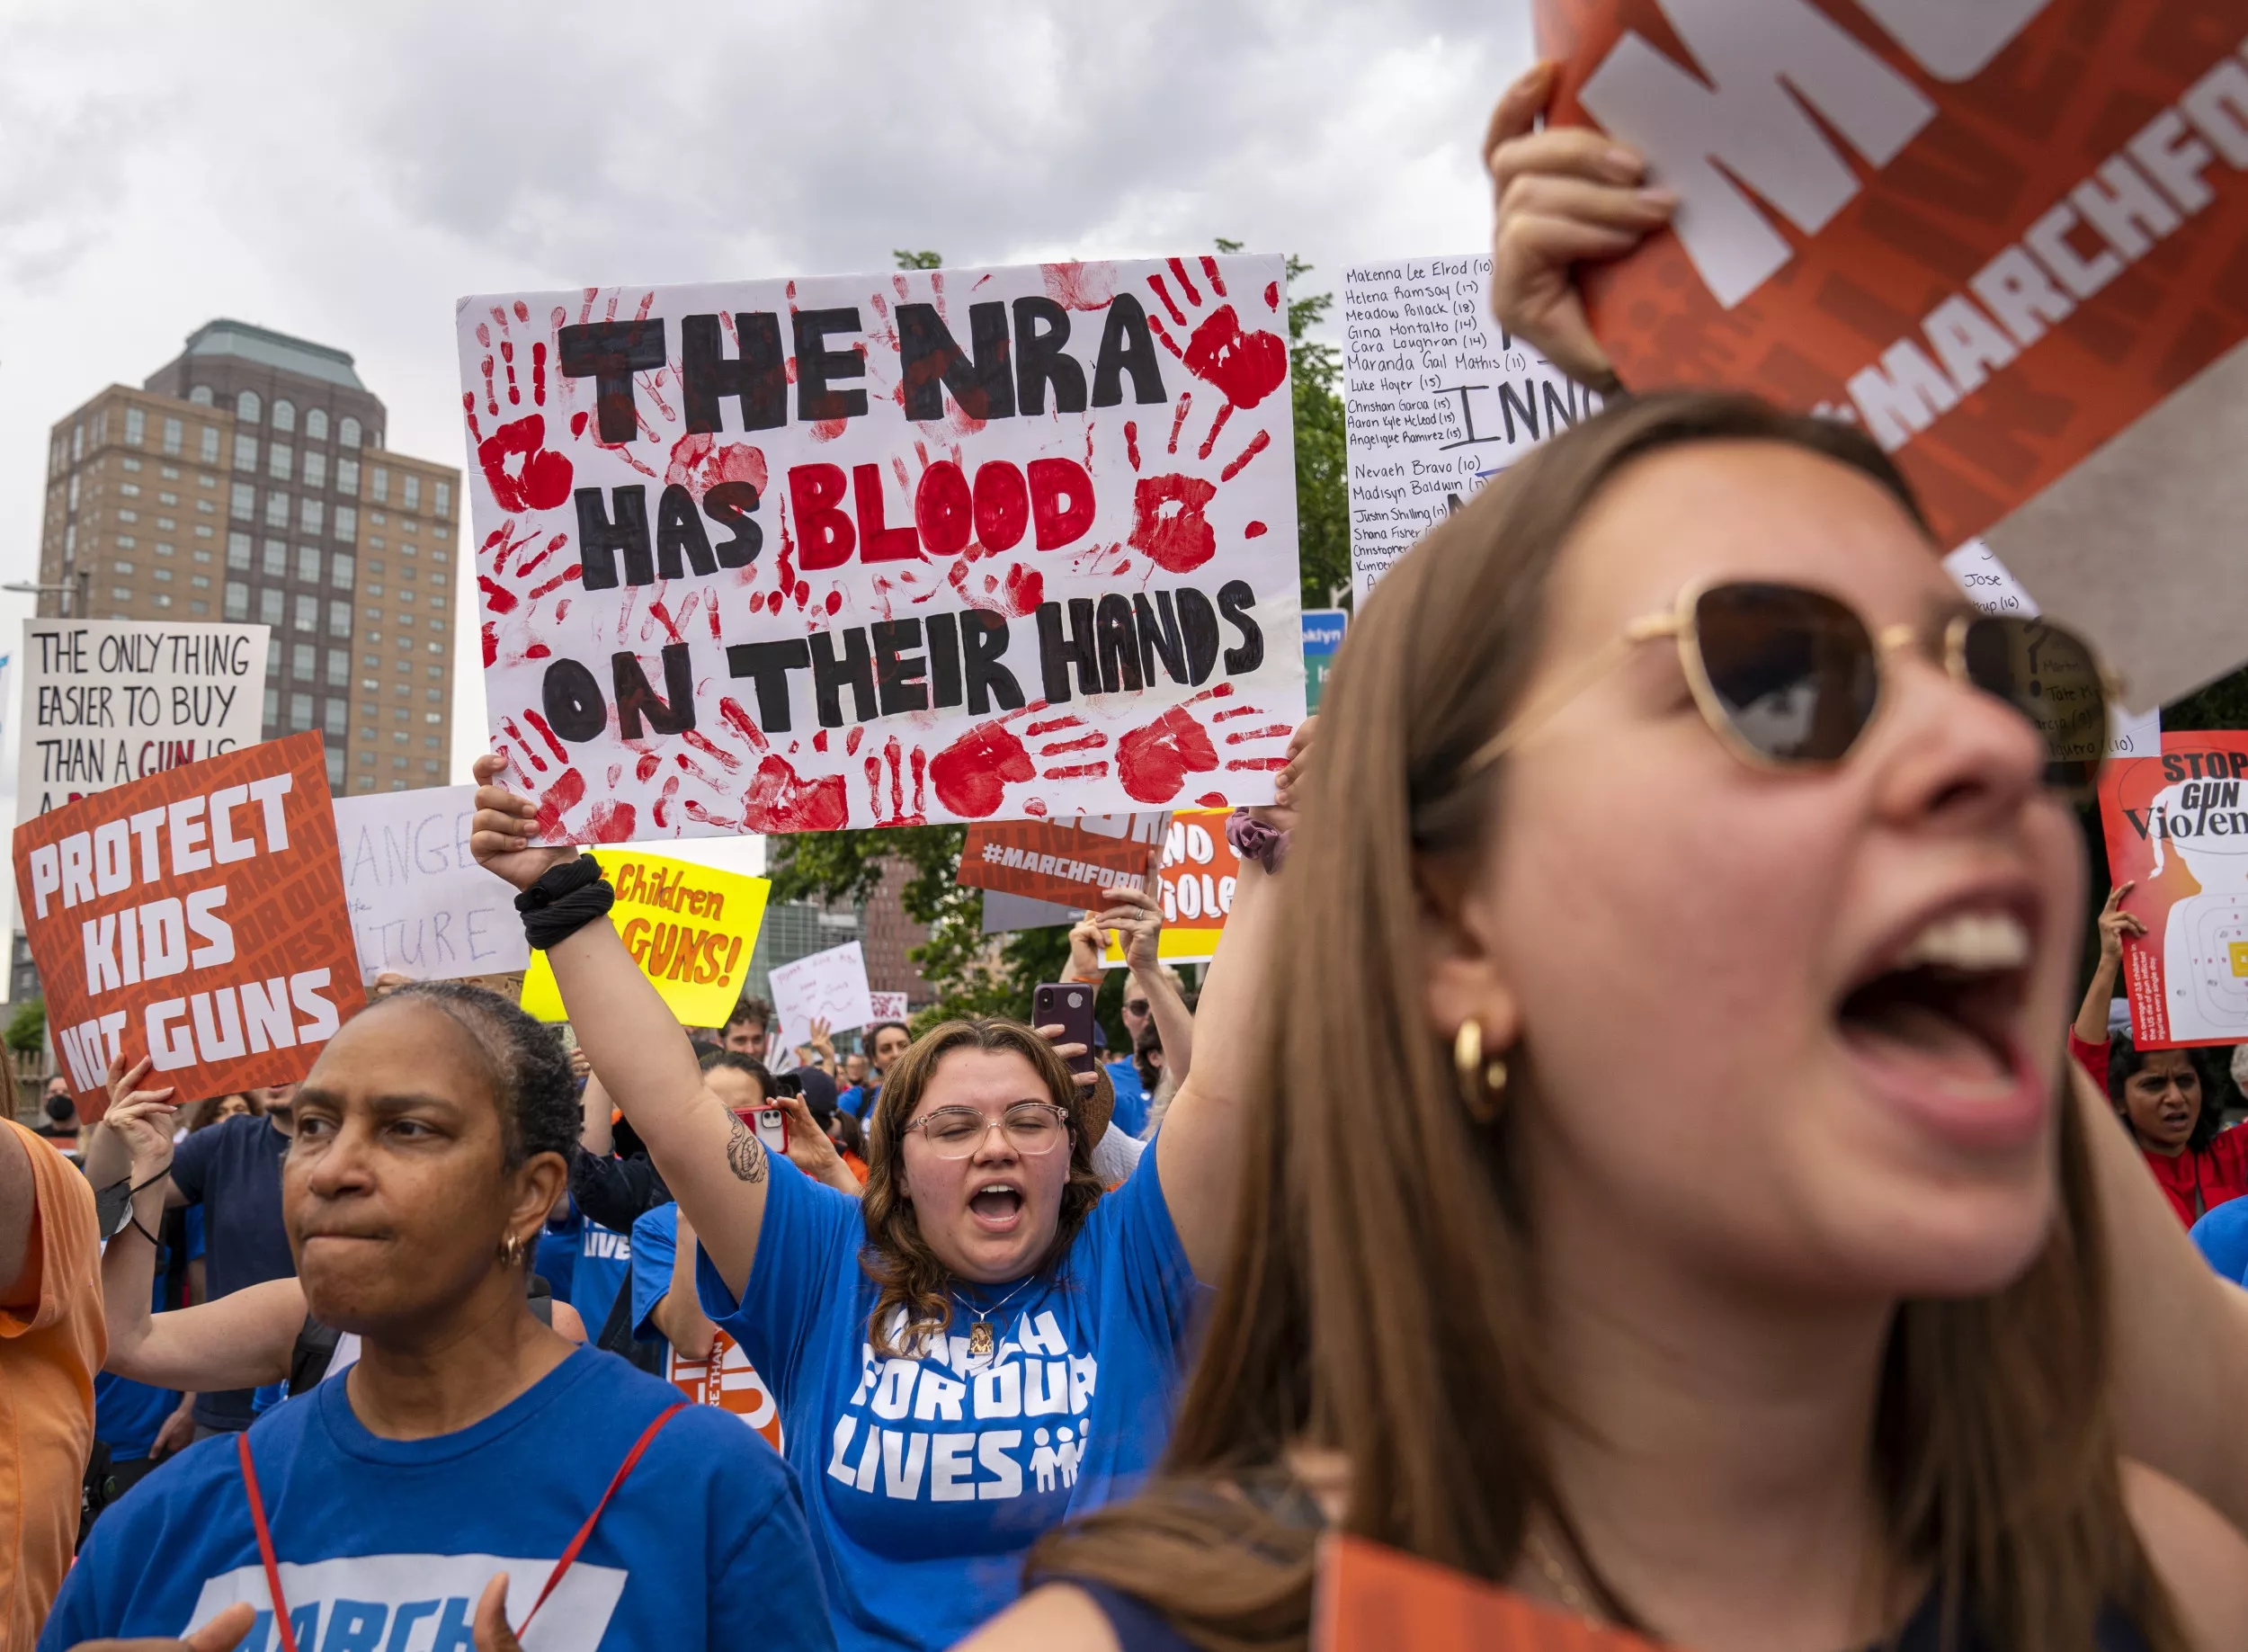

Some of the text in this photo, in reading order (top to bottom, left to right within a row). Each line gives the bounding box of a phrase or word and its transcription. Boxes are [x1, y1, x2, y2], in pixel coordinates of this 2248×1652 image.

[1811, 36, 2248, 453] MARCHFO
[1347, 259, 1494, 283] Makenna Lee Elrod (10)
[1345, 281, 1478, 306] Helena Ramsay (17)
[1345, 299, 1476, 322] Meadow Pollack (18)
[1348, 316, 1477, 340] Gina Montalto (14)
[1351, 340, 1385, 353] Cara
[1393, 336, 1458, 353] Loughran
[1463, 333, 1487, 350] (14)
[558, 292, 1167, 444] THE NRA
[1347, 351, 1526, 372] Maranda Gail Mathis (11)
[1351, 374, 1441, 395] Luke Hoyer (15)
[1348, 397, 1450, 414] Christian Garcia (15)
[1348, 411, 1456, 431] Aaron Kyle McLeod (15)
[1350, 427, 1462, 451] Angelique Ramirez (15)
[1355, 454, 1481, 479] Nevaeh Bravo (10)
[1352, 485, 1406, 504] Madisyn
[1410, 479, 1463, 496] Baldwin
[574, 458, 1097, 591] HAS BLOOD
[1353, 509, 1389, 522] Justin
[1390, 507, 1432, 527] Shilling
[1354, 528, 1387, 540] Shana
[1391, 526, 1421, 539] Fisher
[1353, 544, 1409, 558] Christopher
[1965, 574, 2002, 587] Jose
[2001, 595, 2020, 611] (16)
[32, 630, 250, 676] THE ONLY THING
[541, 579, 1263, 743] ON THEIR HANDS
[39, 685, 236, 728] EASIER TO BUY
[2034, 719, 2068, 730] arcia
[37, 738, 104, 783] THAN
[114, 739, 130, 783] A
[138, 739, 195, 779] GUN
[2049, 742, 2095, 761] lguero
[2162, 752, 2248, 782] STOP
[2181, 781, 2240, 810] GUN
[30, 772, 292, 920] PROTECT
[345, 809, 479, 889] ANGE
[1163, 820, 1214, 868] ND
[615, 862, 725, 922] Children
[83, 884, 236, 996] KIDS
[622, 916, 743, 988] GUNS!
[60, 967, 339, 1093] NOT GUNS
[709, 1342, 723, 1406] RE THAN
[850, 1343, 967, 1421] FOR
[974, 1352, 1097, 1419] OUR
[827, 1413, 1023, 1502] LIVES
